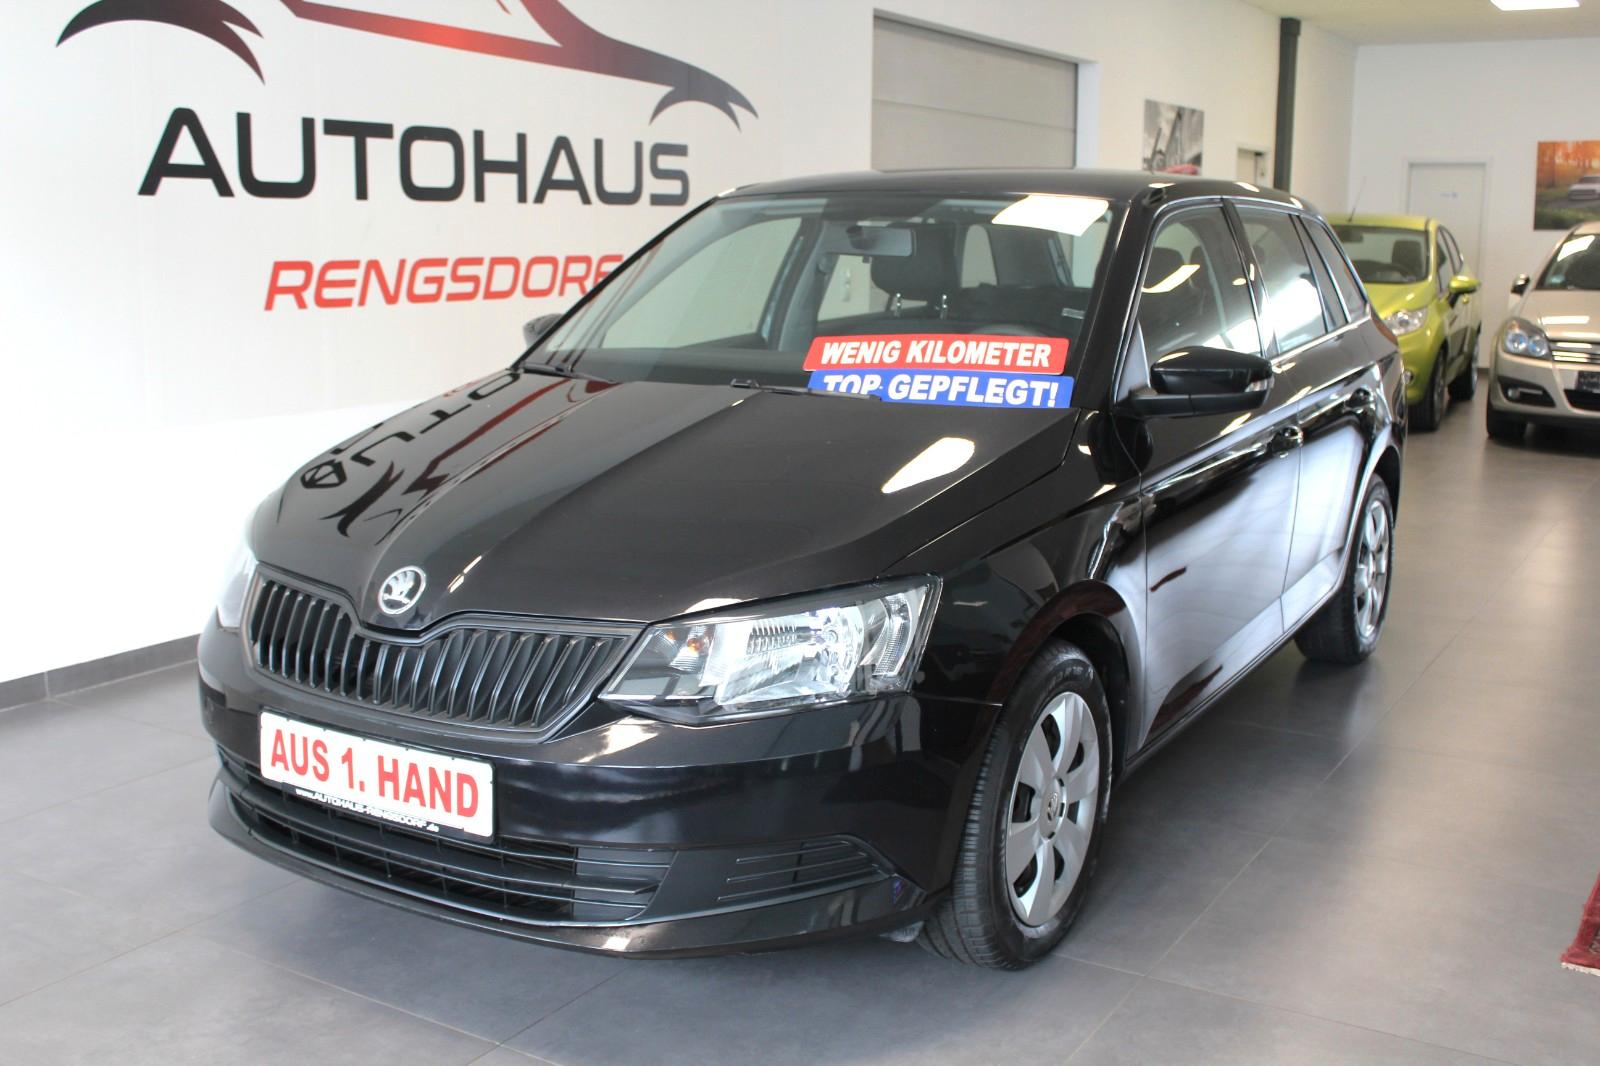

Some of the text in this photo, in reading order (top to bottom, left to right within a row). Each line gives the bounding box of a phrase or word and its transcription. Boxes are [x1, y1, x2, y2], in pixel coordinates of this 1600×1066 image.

[138, 107, 690, 206] AUTOHAUS
[820, 339, 1052, 368] WENIG KILOMETER
[823, 374, 1060, 408] TOP GEPFLEGT!
[270, 728, 480, 818] AUS 1. HAND
